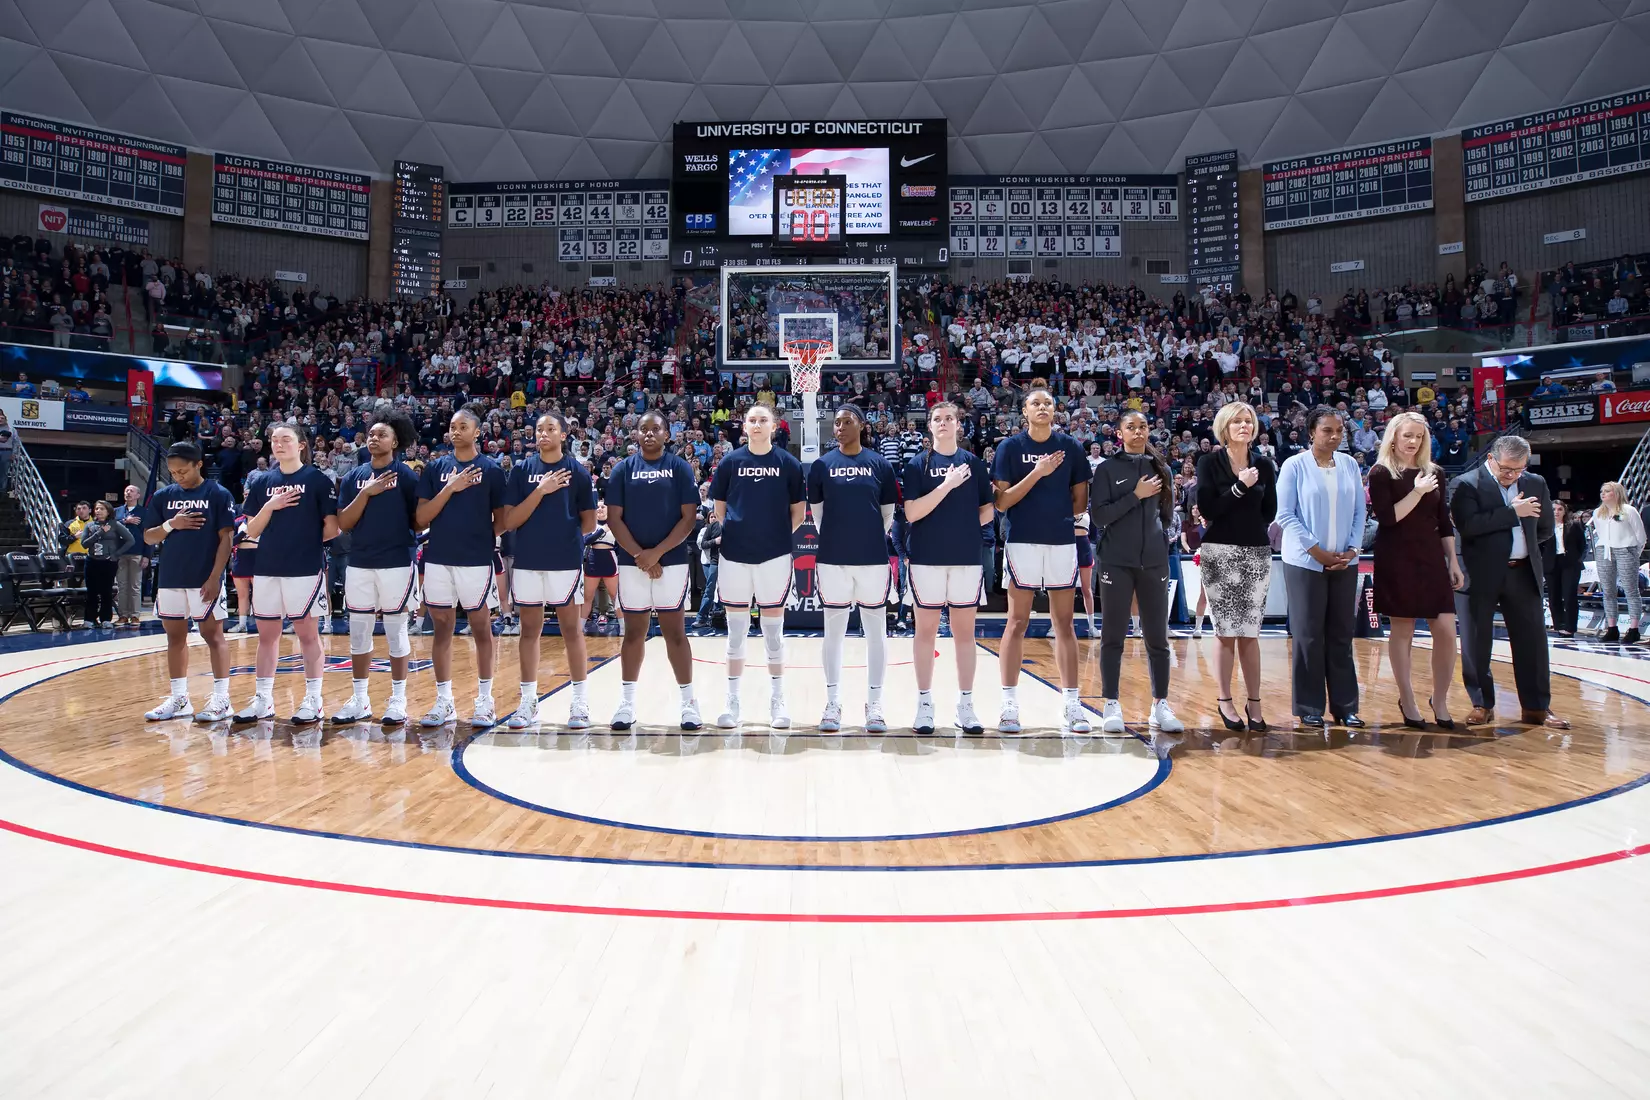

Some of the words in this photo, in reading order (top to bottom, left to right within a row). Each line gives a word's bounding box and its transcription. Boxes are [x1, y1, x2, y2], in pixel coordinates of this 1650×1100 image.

[697, 123, 786, 137] UNIVERSITY
[791, 123, 810, 135] OF
[815, 123, 922, 135] CONNECTICUT
[1473, 122, 1515, 138] NCAA
[1511, 124, 1552, 138] SWEET
[1559, 111, 1614, 128] SIXTEEN
[10, 116, 59, 131] NATIONAL
[62, 126, 115, 142] INVITATION
[118, 137, 179, 154] TOURNAMENT
[1467, 147, 1487, 160] 1956
[1494, 141, 1514, 155] 1964
[1522, 136, 1542, 149] 1976
[1551, 129, 1572, 143] 1990
[1581, 123, 1601, 137] 1991
[1611, 116, 1633, 130] 1994
[55, 134, 139, 156] APPEARANCES
[4, 134, 25, 148] 1955
[33, 139, 53, 153] 1974
[60, 144, 80, 158] 1975
[87, 149, 107, 163] 1980
[114, 154, 132, 168] 1981
[139, 159, 158, 172] 1982
[1187, 157, 1198, 165] GO
[1200, 152, 1235, 163] HUSKIES
[1272, 160, 1307, 172] NCAA
[1314, 141, 1420, 165] CHAMPIONSHIP
[1468, 162, 1487, 176] 1996
[1495, 157, 1515, 170] 1998
[1523, 151, 1543, 165] 1999
[1551, 145, 1573, 160] 2002
[1581, 139, 1605, 153] 2003
[1611, 132, 1635, 147] 2004
[32, 154, 52, 168] 1993
[59, 159, 79, 173] 1997
[86, 165, 106, 178] 2001
[112, 169, 132, 183] 2010
[138, 174, 158, 187] 2015
[225, 156, 260, 169] NCAA
[267, 163, 362, 183] CHAMPIONSHIP
[1194, 167, 1208, 175] STAT
[1209, 164, 1230, 173] BOARD
[1272, 164, 1339, 180] TOURNAMENT
[1344, 150, 1422, 169] APPEARANCES
[223, 165, 290, 181] TOURNAMENT
[295, 176, 364, 192] APPEARANCES
[1266, 181, 1284, 192] 2000
[1288, 177, 1307, 189] 2002
[1312, 173, 1330, 185] 2003
[1383, 162, 1403, 174] 2006
[1468, 178, 1489, 191] 2009
[1496, 172, 1516, 186] 2011
[1523, 166, 1544, 180] 2014
[1471, 181, 1545, 199] CONNECTICUT
[1550, 173, 1584, 184] MEN'S
[1589, 161, 1650, 177] BASKETBA
[531, 182, 570, 190] HUSKIES
[1290, 192, 1306, 203] 2011
[1313, 188, 1330, 199] 2012
[1336, 184, 1354, 196] 2014
[1360, 181, 1378, 193] 2016
[4, 179, 81, 197] CONNECTICUT
[82, 192, 112, 204] MEN'S
[117, 200, 179, 215] BASKETBALL
[485, 208, 493, 221] 9
[507, 208, 526, 221] 22
[534, 208, 554, 221] 25
[562, 207, 582, 220] 42
[590, 206, 610, 219] 44
[646, 205, 666, 218] 42
[953, 202, 973, 215] 52
[1011, 202, 1031, 215] 00
[1041, 202, 1058, 215] 13
[1068, 202, 1089, 215] 42
[1101, 202, 1113, 214] 34
[1130, 202, 1142, 215] 32
[1159, 202, 1171, 215] 50
[44, 214, 64, 225] NIT
[95, 213, 124, 225] 1988
[455, 209, 467, 222] C
[1269, 216, 1330, 229] CONNECTICUT
[1334, 210, 1362, 220] MEN'S
[1366, 202, 1428, 215] BASKETBALL
[217, 214, 278, 228] CONNECTICUT
[311, 226, 364, 239] BASKETBALL
[791, 210, 829, 242] 30
[1573, 230, 1580, 238] 8
[562, 242, 581, 255] 24
[592, 241, 607, 254] 13
[618, 241, 637, 254] 22
[958, 238, 968, 251] 15
[986, 238, 998, 251] 22
[1043, 238, 1056, 251] 42
[1072, 237, 1085, 250] 13
[683, 250, 692, 264] 0
[939, 248, 947, 261] 0
[1196, 276, 1211, 284] TIME
[1529, 403, 1594, 419] BEAR'S
[1616, 399, 1650, 415] Coca-C
[13, 419, 31, 427] ARMY
[631, 468, 673, 480] UCONN
[738, 467, 780, 477] UCONN
[829, 467, 872, 477] UCONN
[167, 499, 209, 510] UCONN
